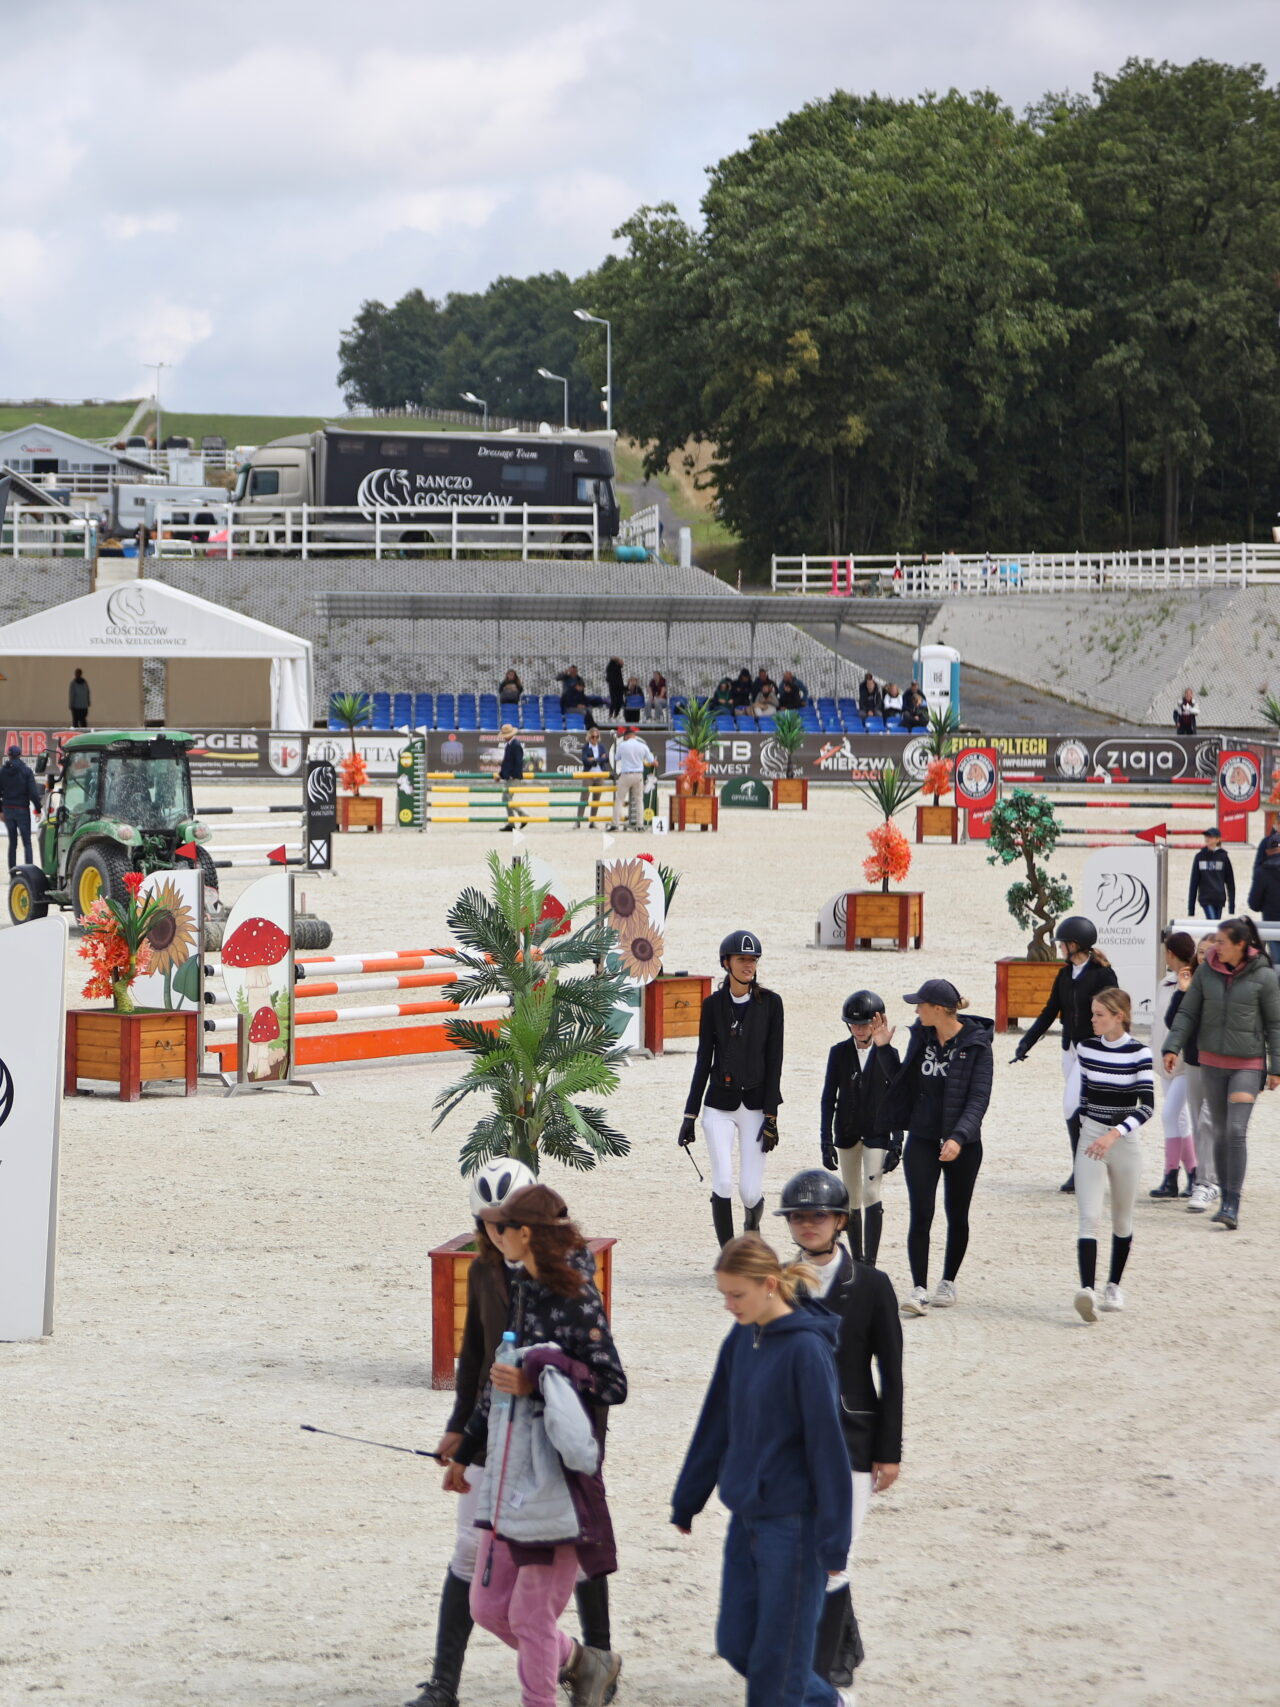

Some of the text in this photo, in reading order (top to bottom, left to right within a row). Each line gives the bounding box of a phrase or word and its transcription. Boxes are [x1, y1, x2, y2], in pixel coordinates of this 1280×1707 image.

[478, 446, 538, 460] Dressage Team
[416, 474, 472, 490] RANCZO
[414, 490, 513, 507] GOŚCISZÓW
[105, 624, 168, 636] GOŚCISZÓW
[4, 731, 47, 756] ATB
[705, 763, 751, 775] INVEST
[821, 756, 896, 771] MIERZWA
[656, 820, 665, 832] 4
[1098, 926, 1132, 936] RANCZO
[1098, 936, 1146, 946] GOŚCISZÓW
